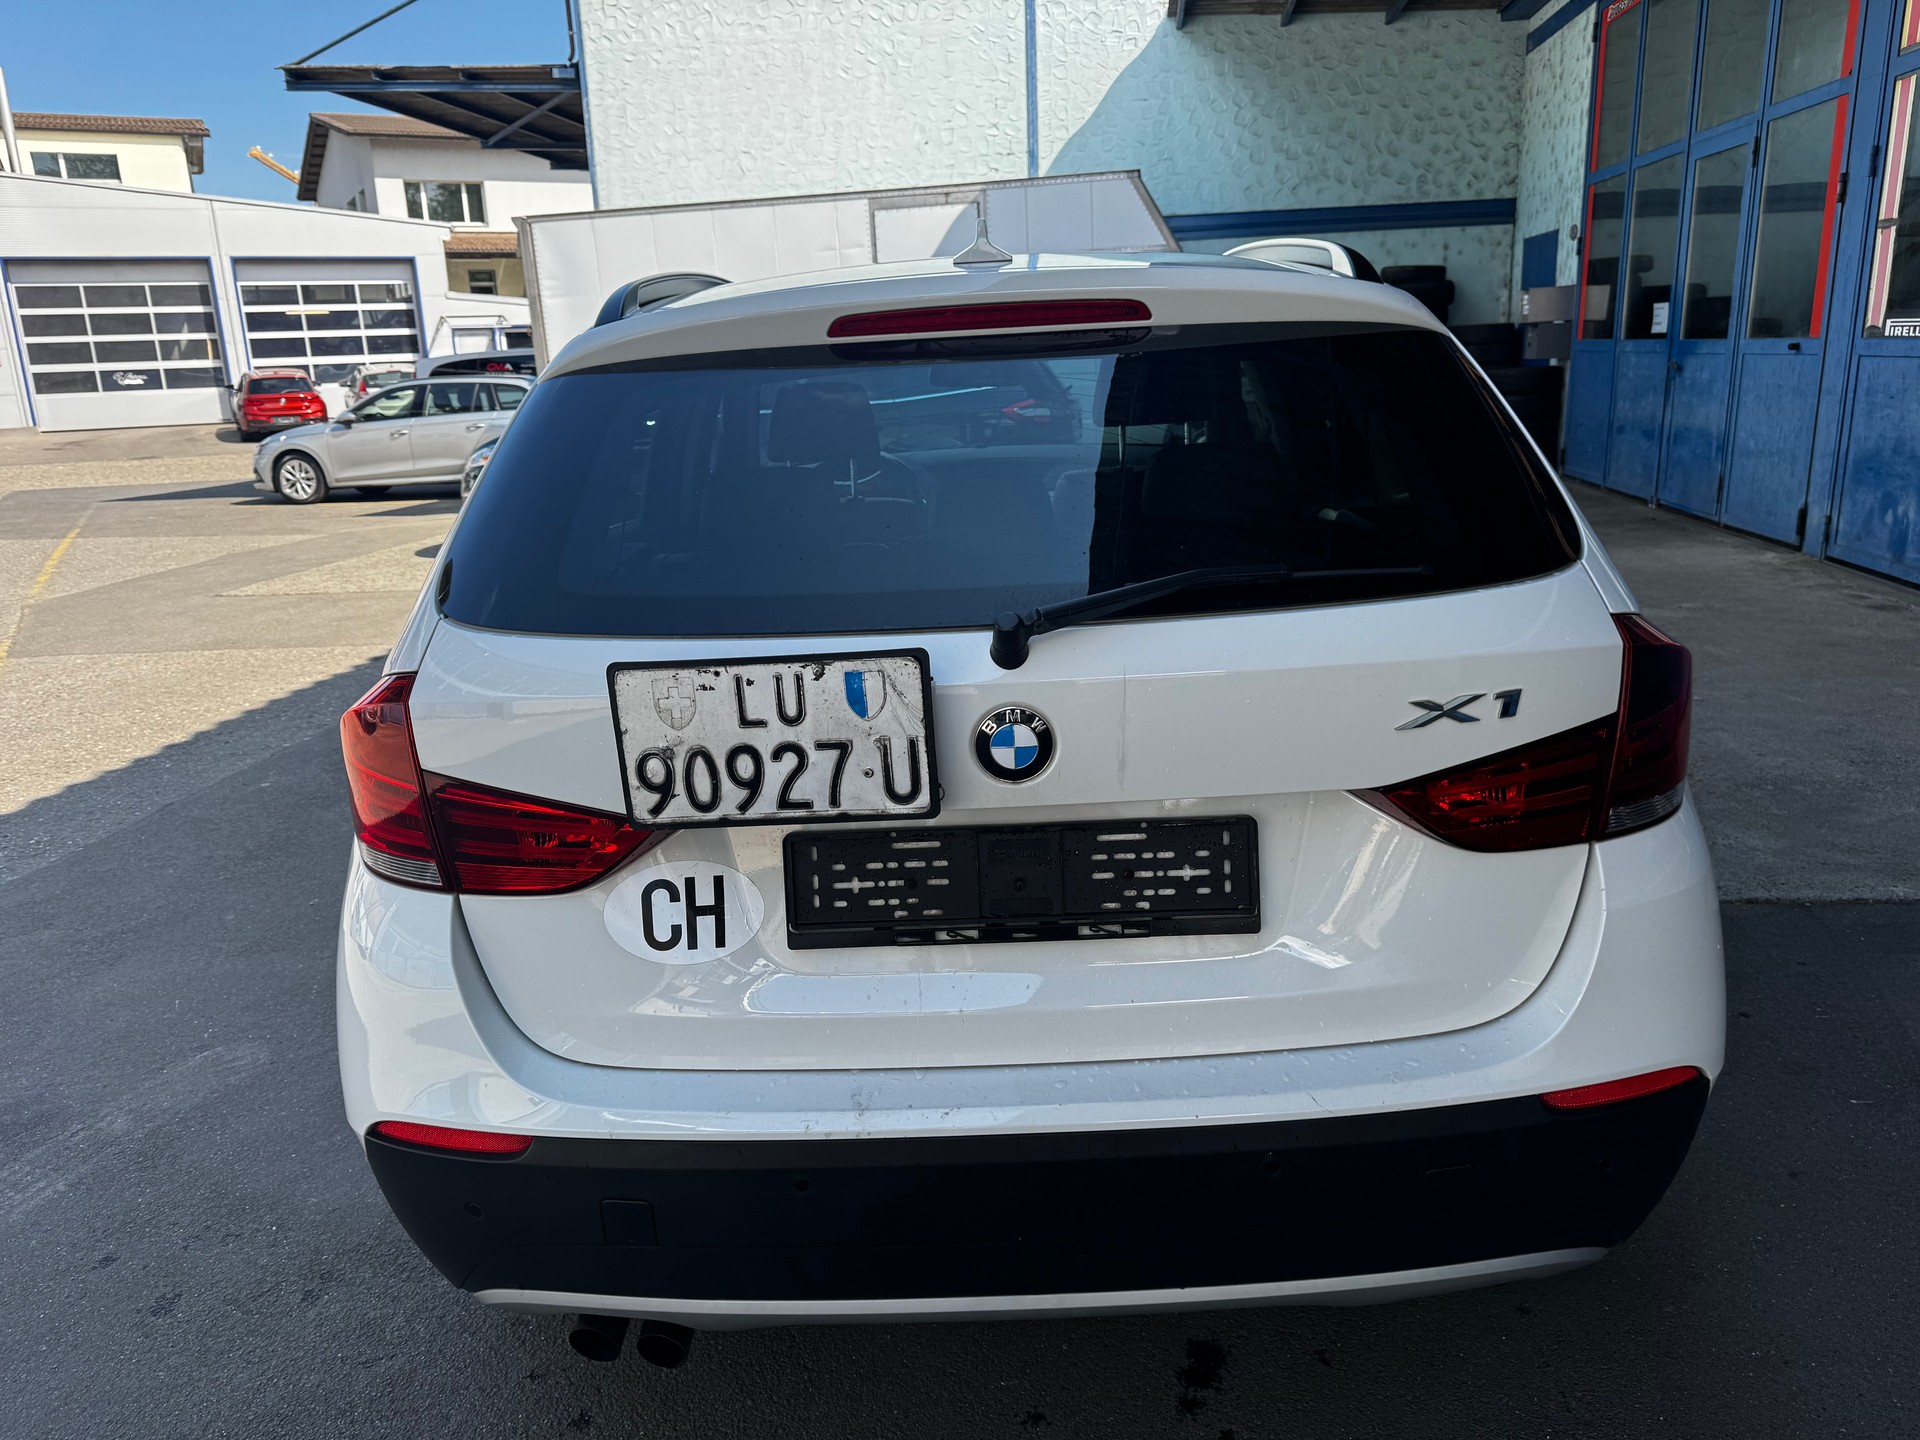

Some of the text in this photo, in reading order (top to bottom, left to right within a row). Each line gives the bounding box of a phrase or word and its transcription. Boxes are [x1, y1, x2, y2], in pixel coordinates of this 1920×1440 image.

[733, 671, 806, 728] LU
[981, 709, 1047, 736] BMW
[1394, 688, 1522, 731] X1
[635, 738, 852, 818] 90927
[641, 875, 726, 952] CH
